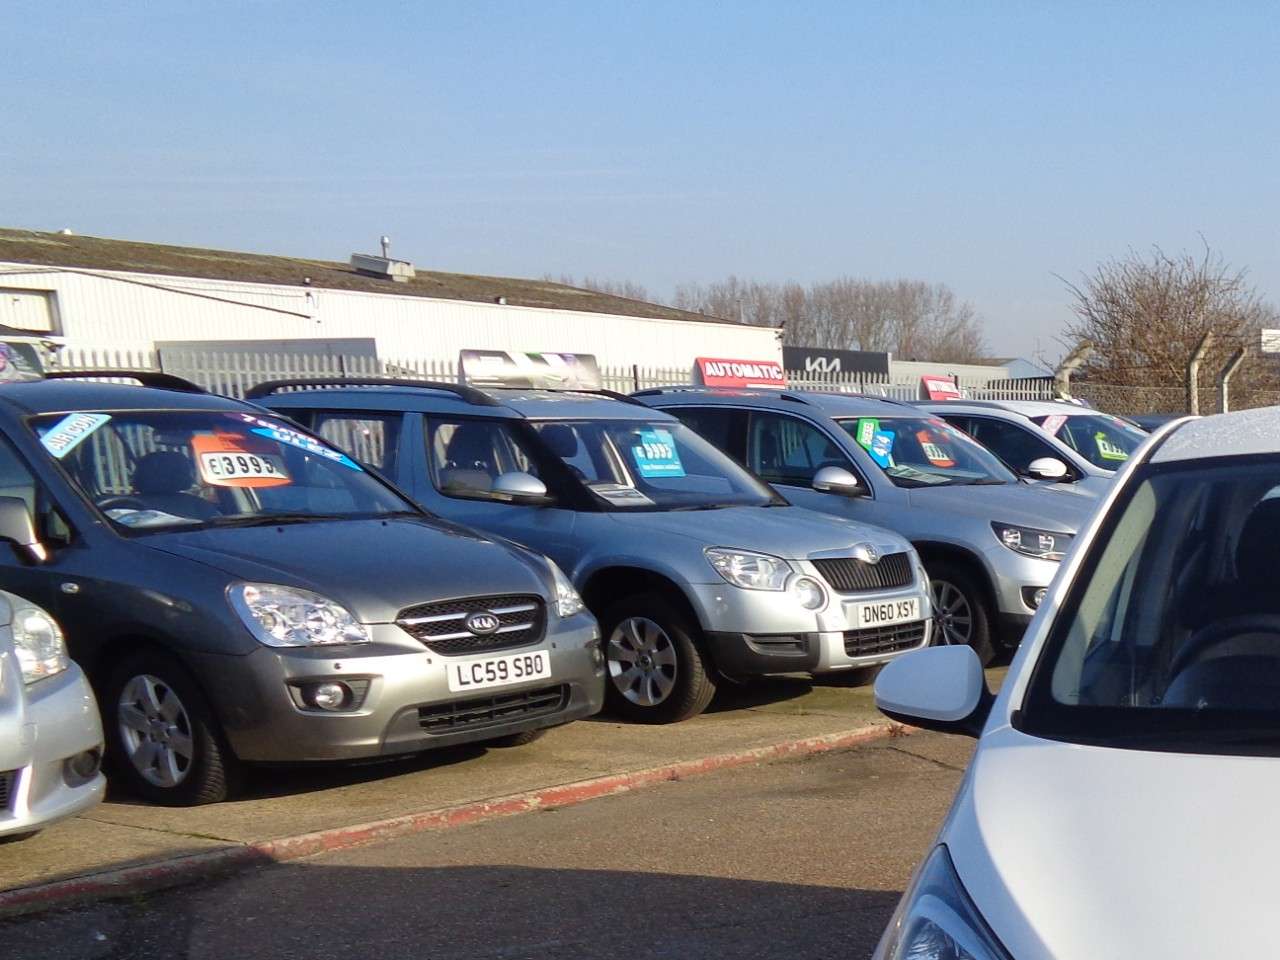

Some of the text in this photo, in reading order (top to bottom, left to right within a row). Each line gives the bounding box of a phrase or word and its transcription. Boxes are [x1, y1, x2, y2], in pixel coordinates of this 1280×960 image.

[704, 361, 783, 380] AUTOMATIC
[864, 599, 915, 623] DN60 XSY
[457, 654, 543, 686] LC59 SBO
